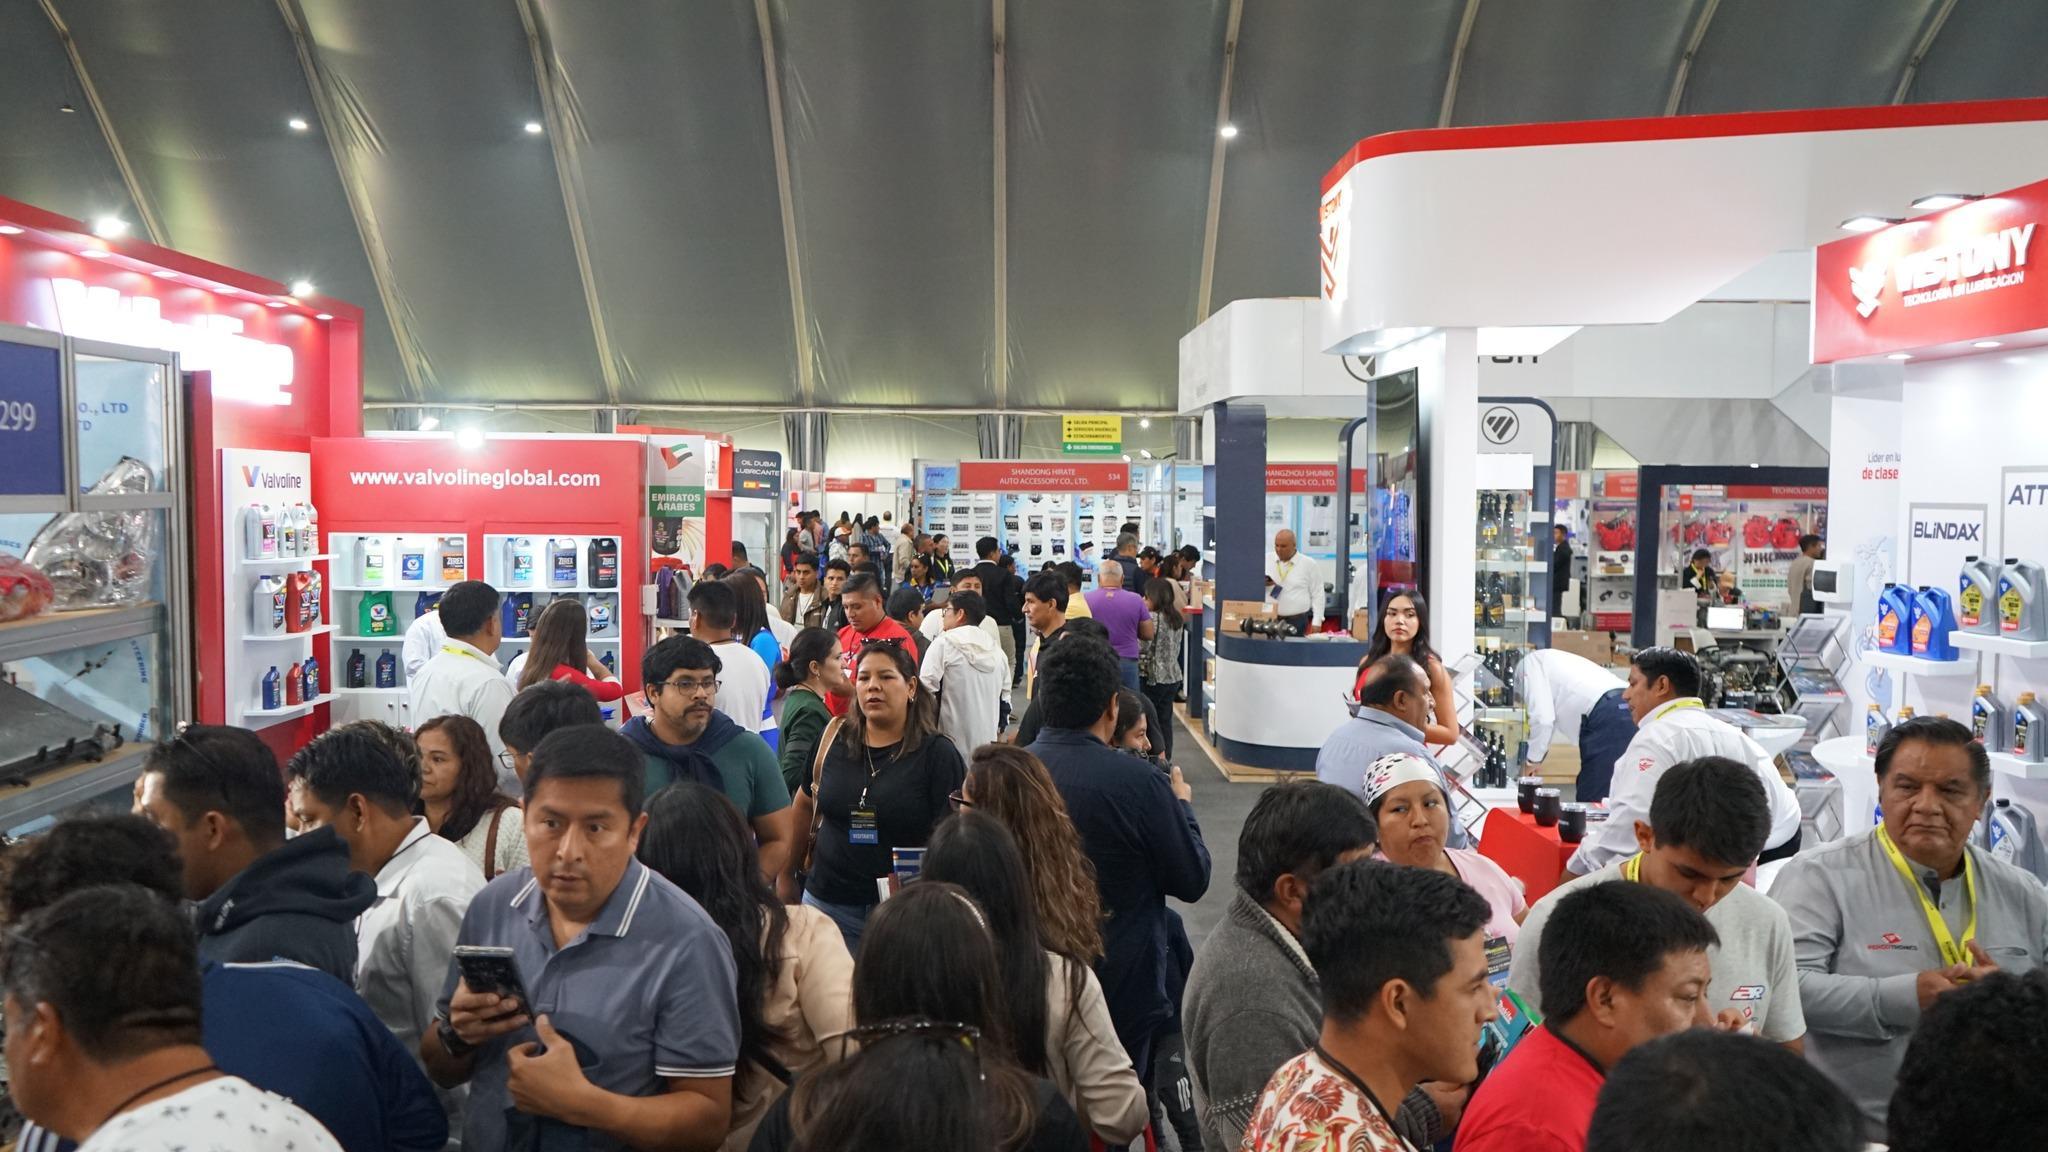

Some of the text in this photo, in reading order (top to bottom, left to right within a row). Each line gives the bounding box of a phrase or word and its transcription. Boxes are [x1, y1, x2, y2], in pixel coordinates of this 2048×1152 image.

[101, 402, 129, 414] LTD
[0, 400, 37, 432] 299
[754, 460, 777, 468] DUBAI
[735, 468, 780, 477] LUBRICANTE
[1011, 468, 1076, 477] SHANDONG HIRATE
[1108, 473, 1121, 481] 534
[1861, 466, 1899, 480] de clase
[261, 472, 302, 489] Valvoline
[349, 467, 602, 490] www.valvolineglobal.com
[999, 477, 1018, 485] AUTO
[1018, 477, 1058, 485] ACCESSORY
[1075, 477, 1089, 485] LTD.
[1771, 487, 1816, 496] TECHNOLOGY
[651, 493, 701, 502] EMIRATOS
[657, 501, 696, 512] ÁRABES
